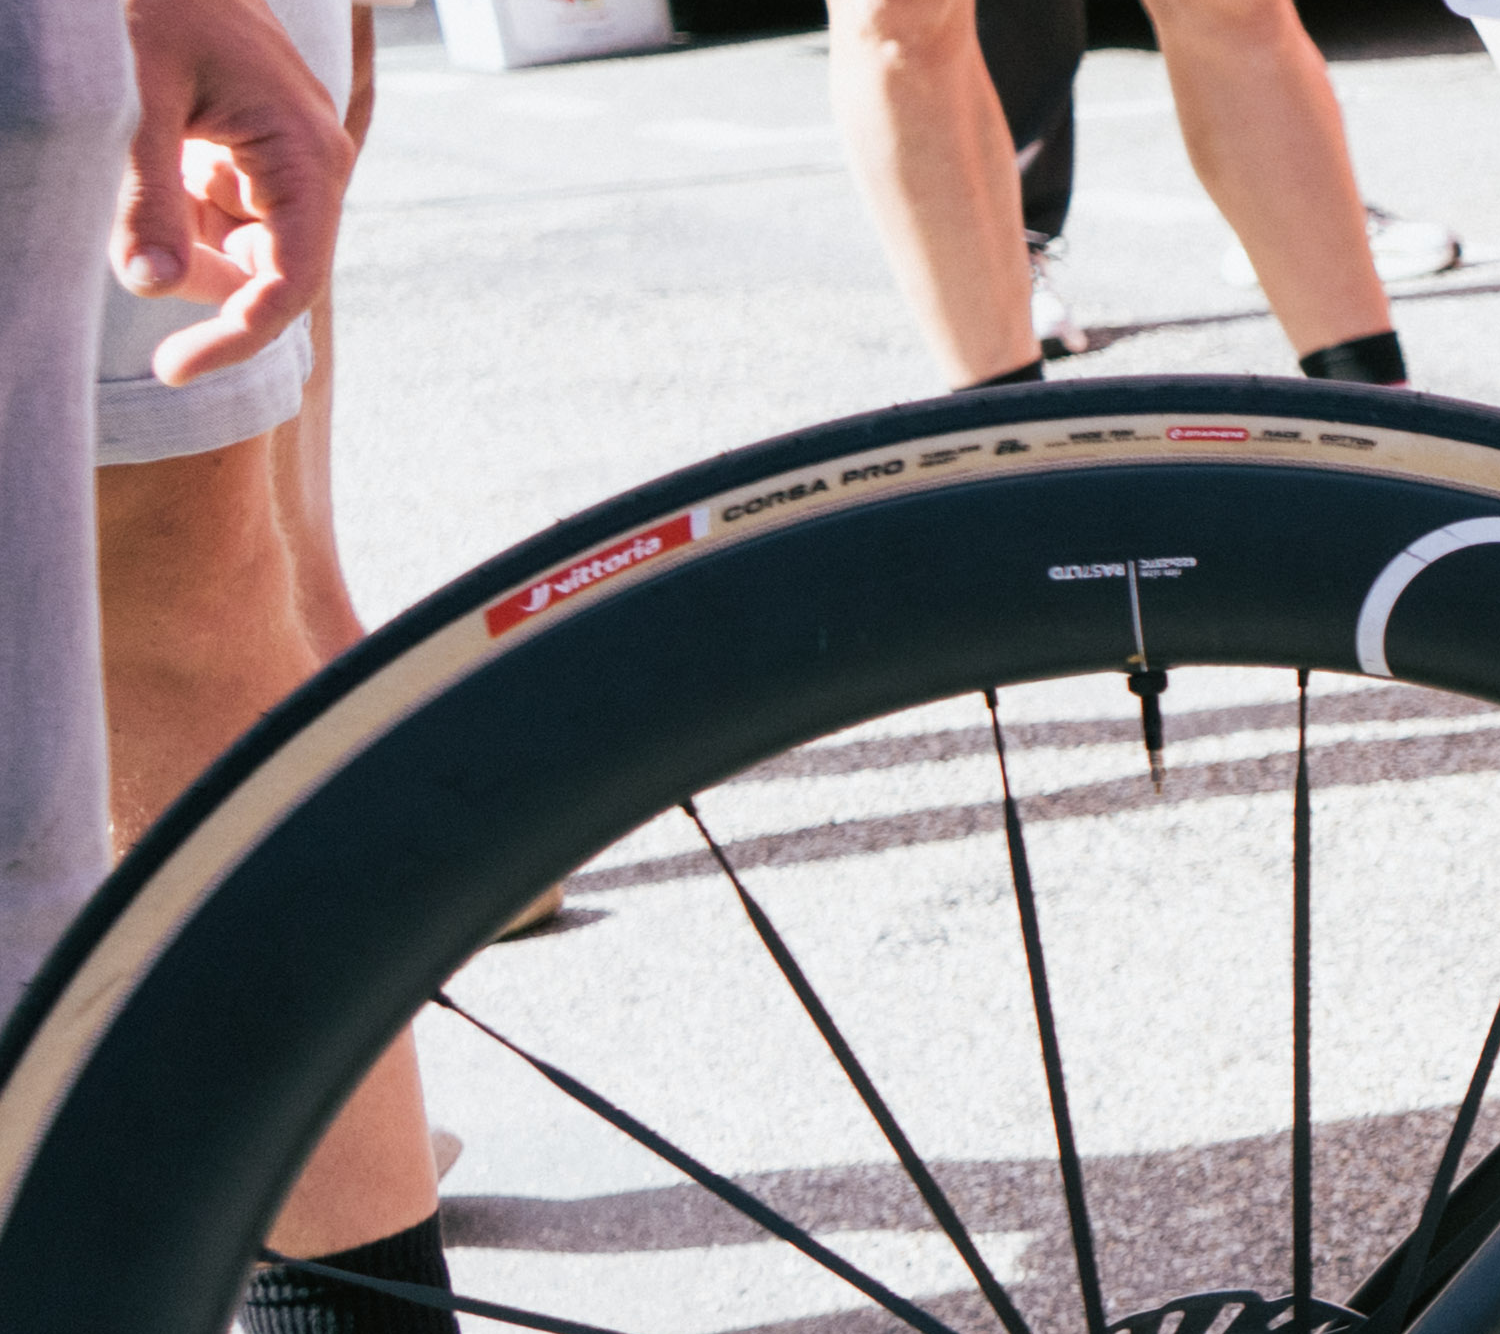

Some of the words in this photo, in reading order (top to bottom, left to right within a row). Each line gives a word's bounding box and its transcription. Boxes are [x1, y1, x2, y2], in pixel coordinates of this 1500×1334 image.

[721, 478, 831, 524] CORSA
[841, 460, 906, 486] PRO
[554, 536, 662, 596] vittoria
